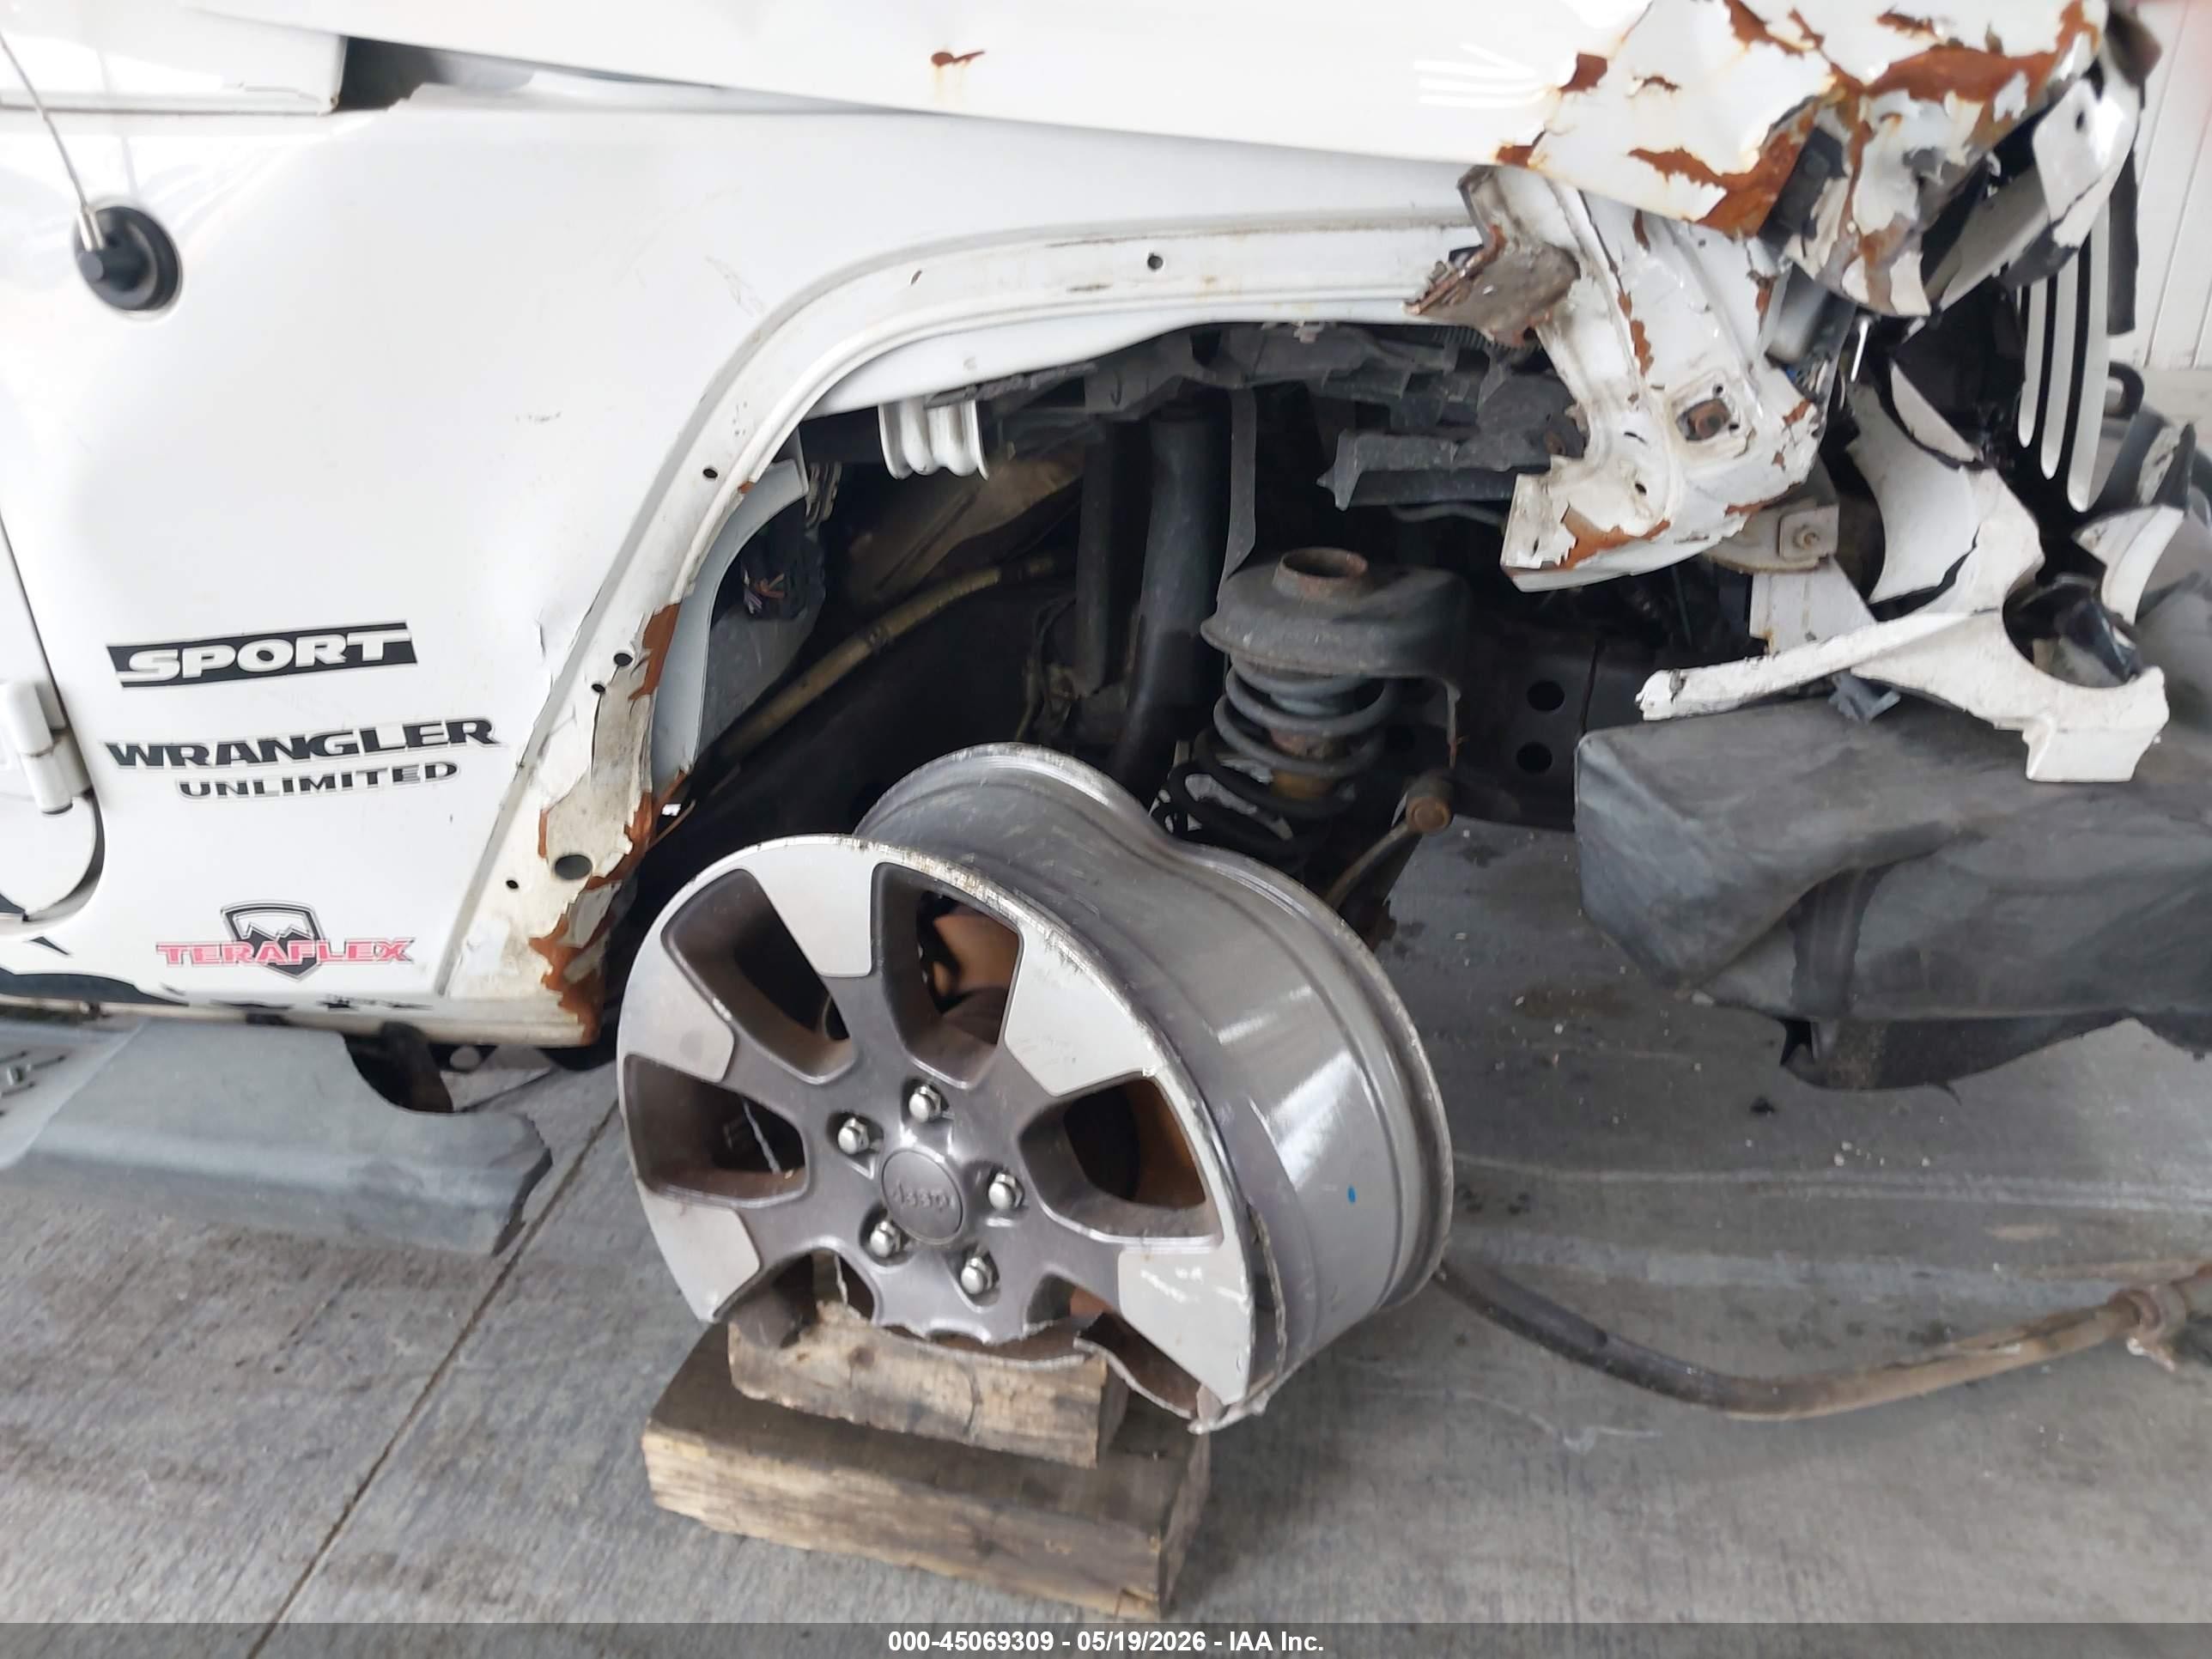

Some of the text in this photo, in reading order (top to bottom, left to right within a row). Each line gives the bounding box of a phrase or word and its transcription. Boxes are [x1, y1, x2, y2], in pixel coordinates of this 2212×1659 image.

[117, 629, 411, 683] SPORT
[104, 718, 501, 768] WRANGLER
[178, 762, 459, 798] UNLIMITED
[155, 937, 416, 967] TERAFLEX
